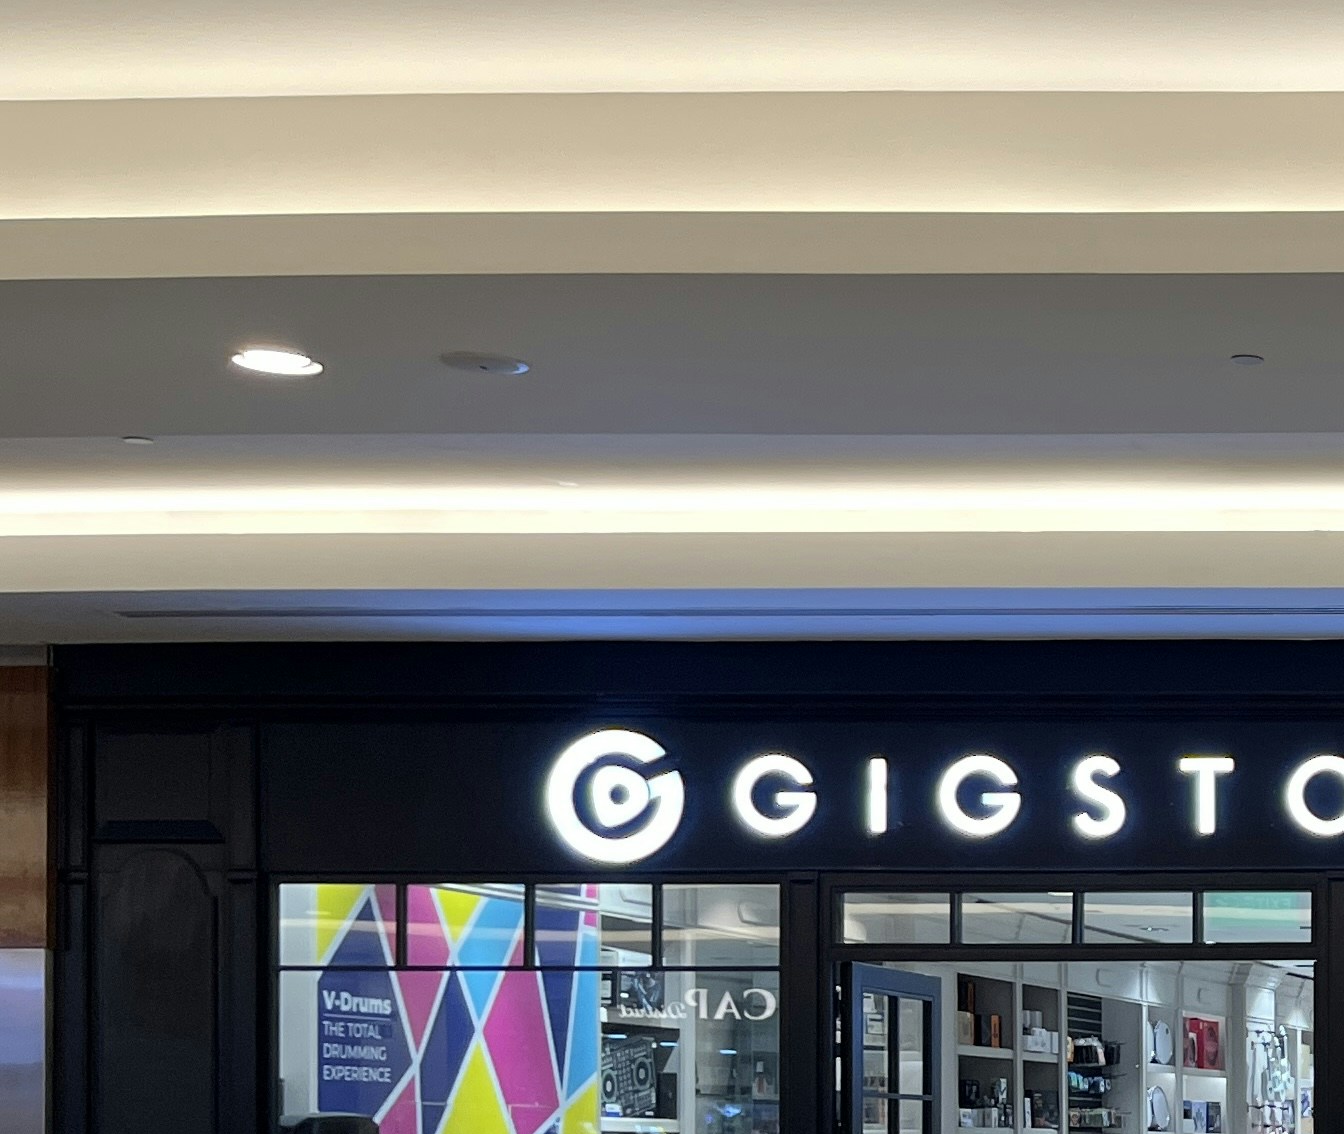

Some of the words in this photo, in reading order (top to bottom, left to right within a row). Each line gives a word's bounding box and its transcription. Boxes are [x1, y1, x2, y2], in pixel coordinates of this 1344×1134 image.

[322, 990, 392, 1015] V-Drums
[322, 1021, 345, 1038] THE
[347, 1022, 382, 1039] TOTAL
[322, 1043, 387, 1061] DRUMMING
[322, 1065, 391, 1083] EXPERIENCE
